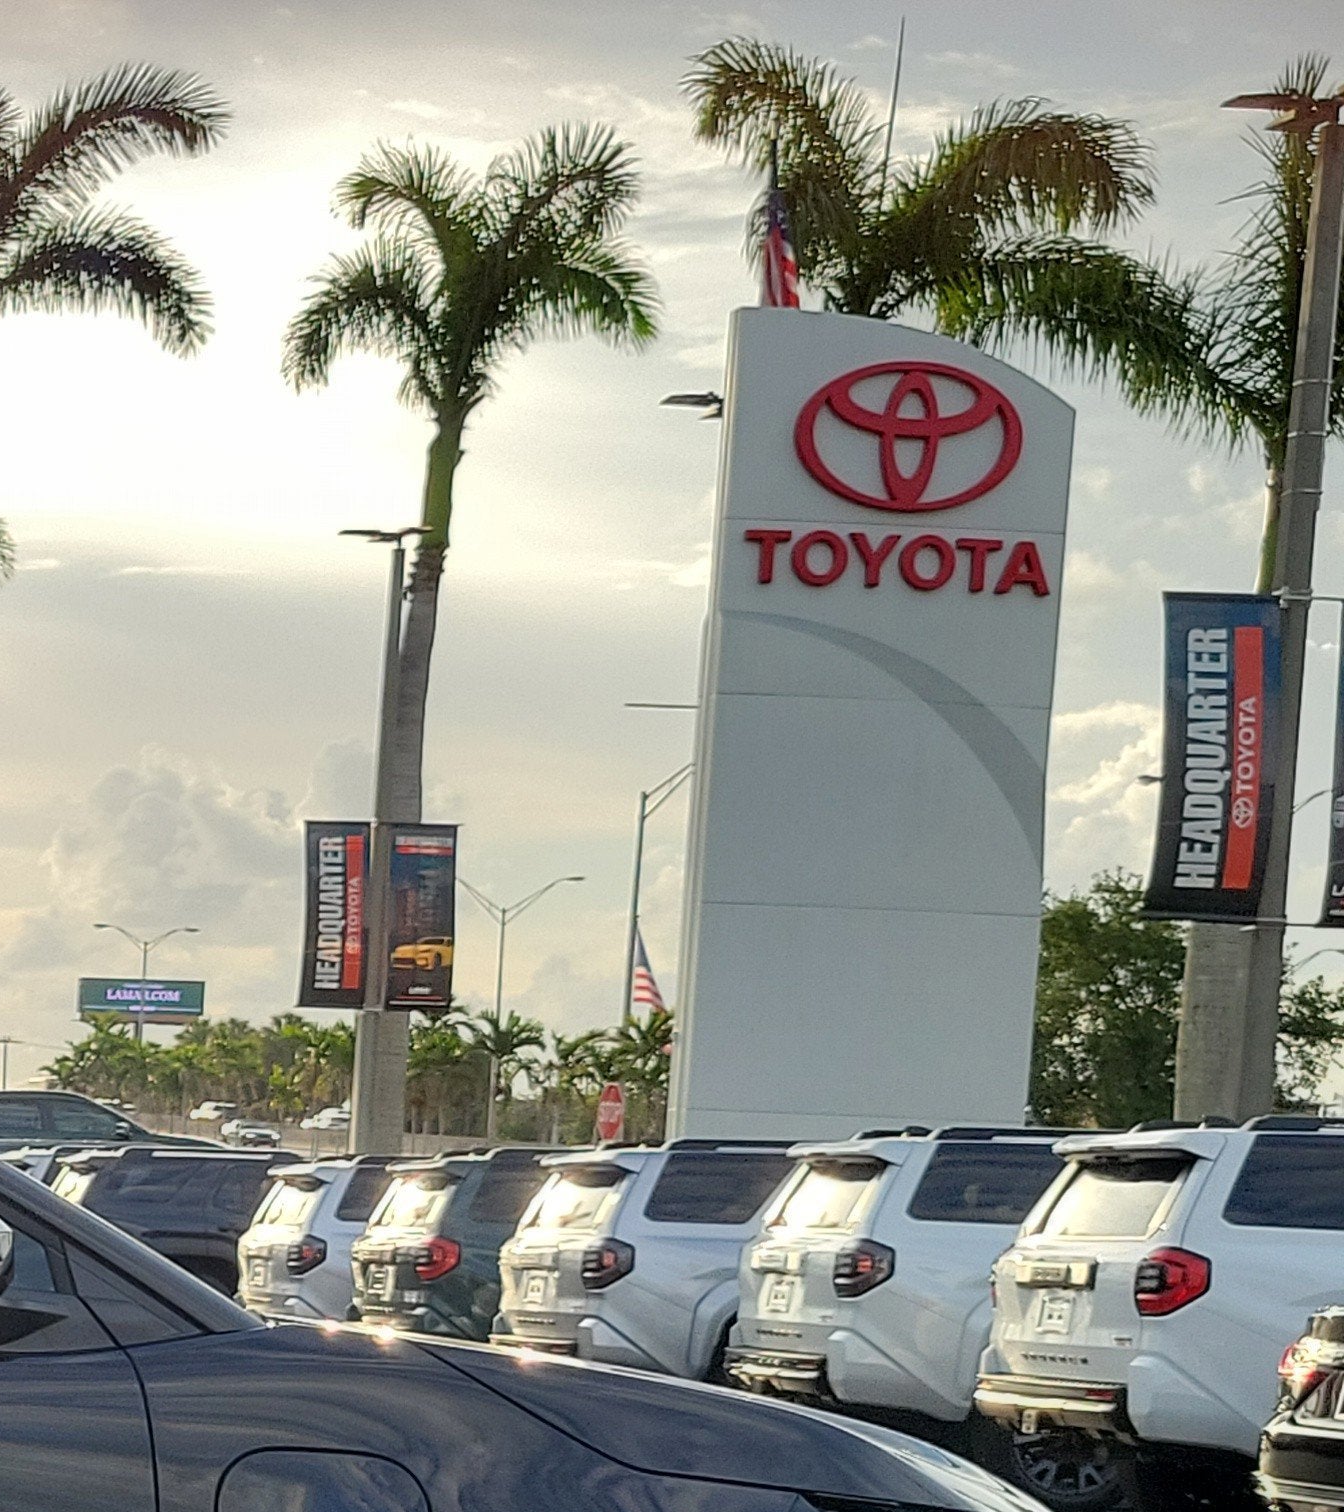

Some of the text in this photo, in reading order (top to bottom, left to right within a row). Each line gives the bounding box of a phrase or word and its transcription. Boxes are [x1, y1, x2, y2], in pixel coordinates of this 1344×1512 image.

[745, 529, 1050, 597] TOYOTA
[1173, 627, 1231, 889] HEADQUARTER
[1236, 697, 1257, 795] TOYOTA
[314, 836, 345, 990] HEADQUARTER
